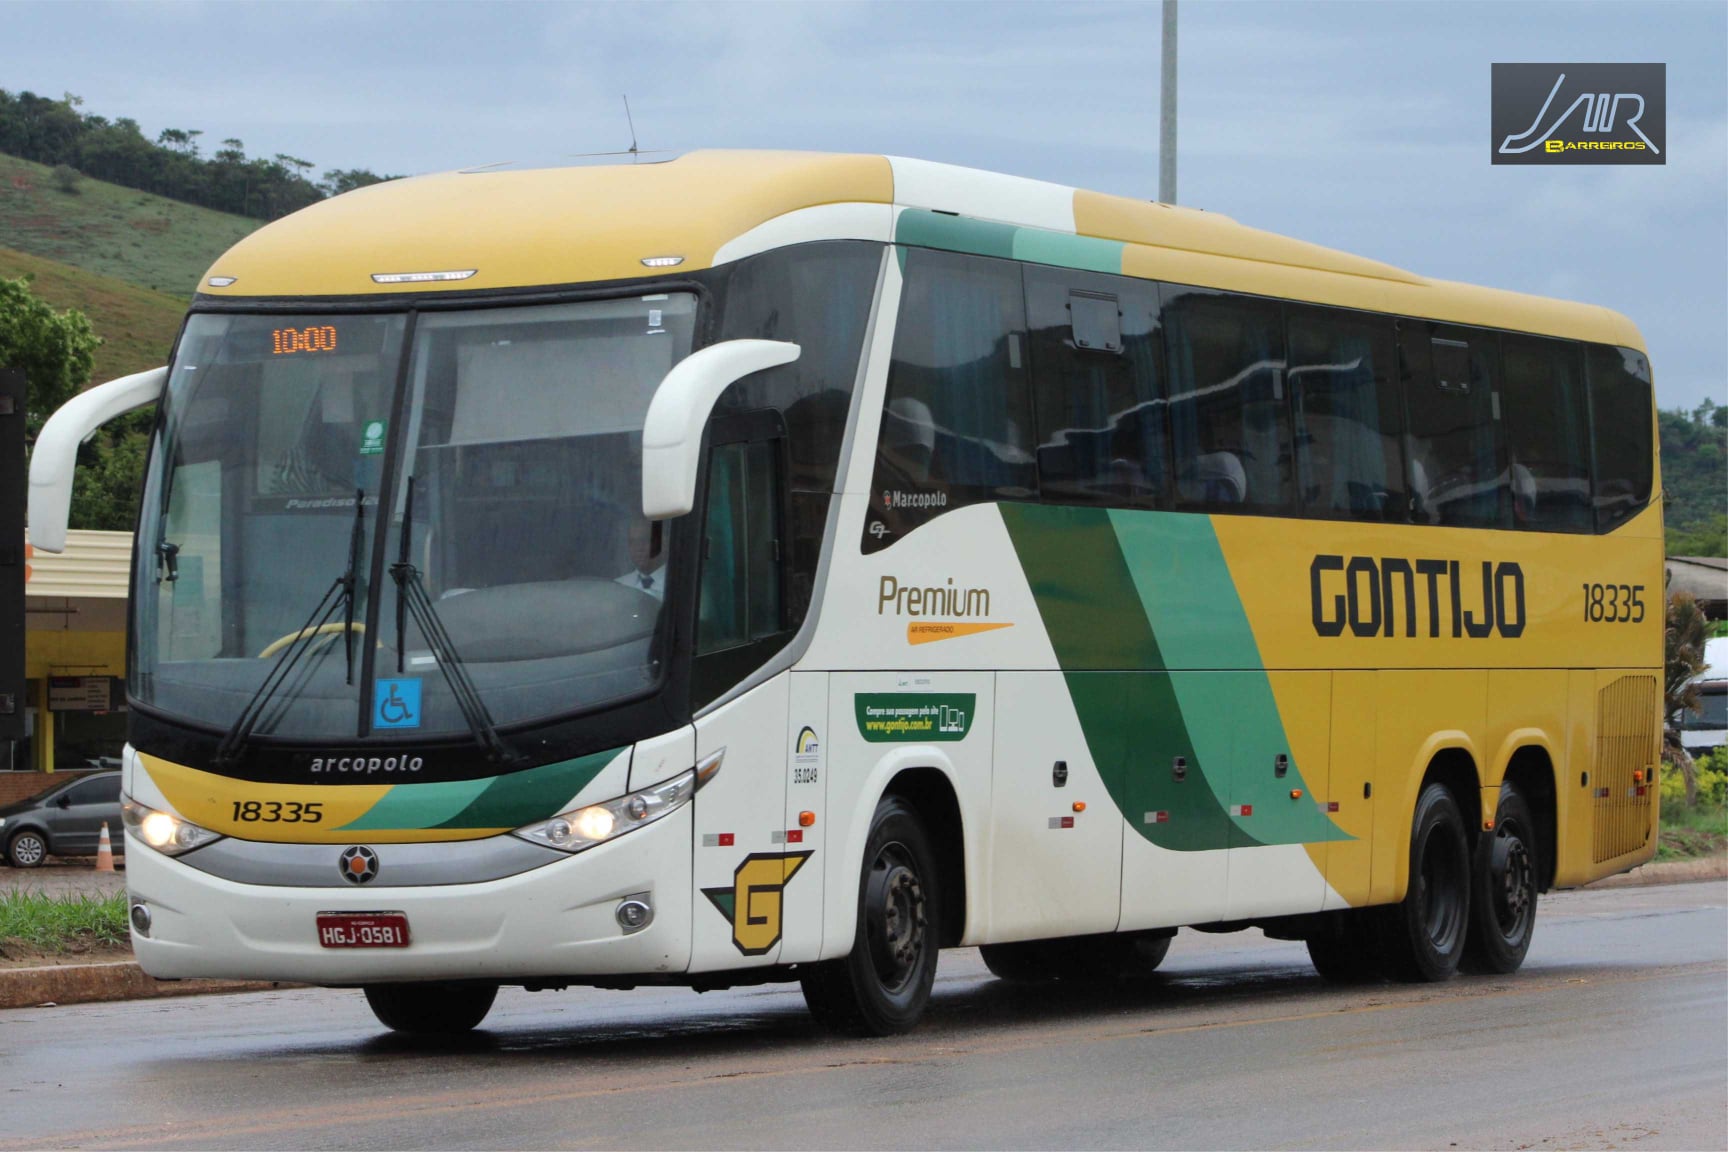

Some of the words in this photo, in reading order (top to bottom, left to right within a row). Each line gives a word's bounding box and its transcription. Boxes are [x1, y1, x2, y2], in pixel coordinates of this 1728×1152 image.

[272, 326, 337, 354] 10:00
[285, 497, 356, 509] Paradiso
[893, 490, 947, 509] Marcopolo
[878, 575, 990, 617] Premium
[1310, 554, 1526, 638] GONTIJO
[1582, 583, 1646, 623] 18335
[866, 716, 932, 734] www.gontijo.com.br
[805, 743, 819, 752] ANTT
[310, 754, 424, 774] arcopolo
[233, 801, 323, 823] 18335
